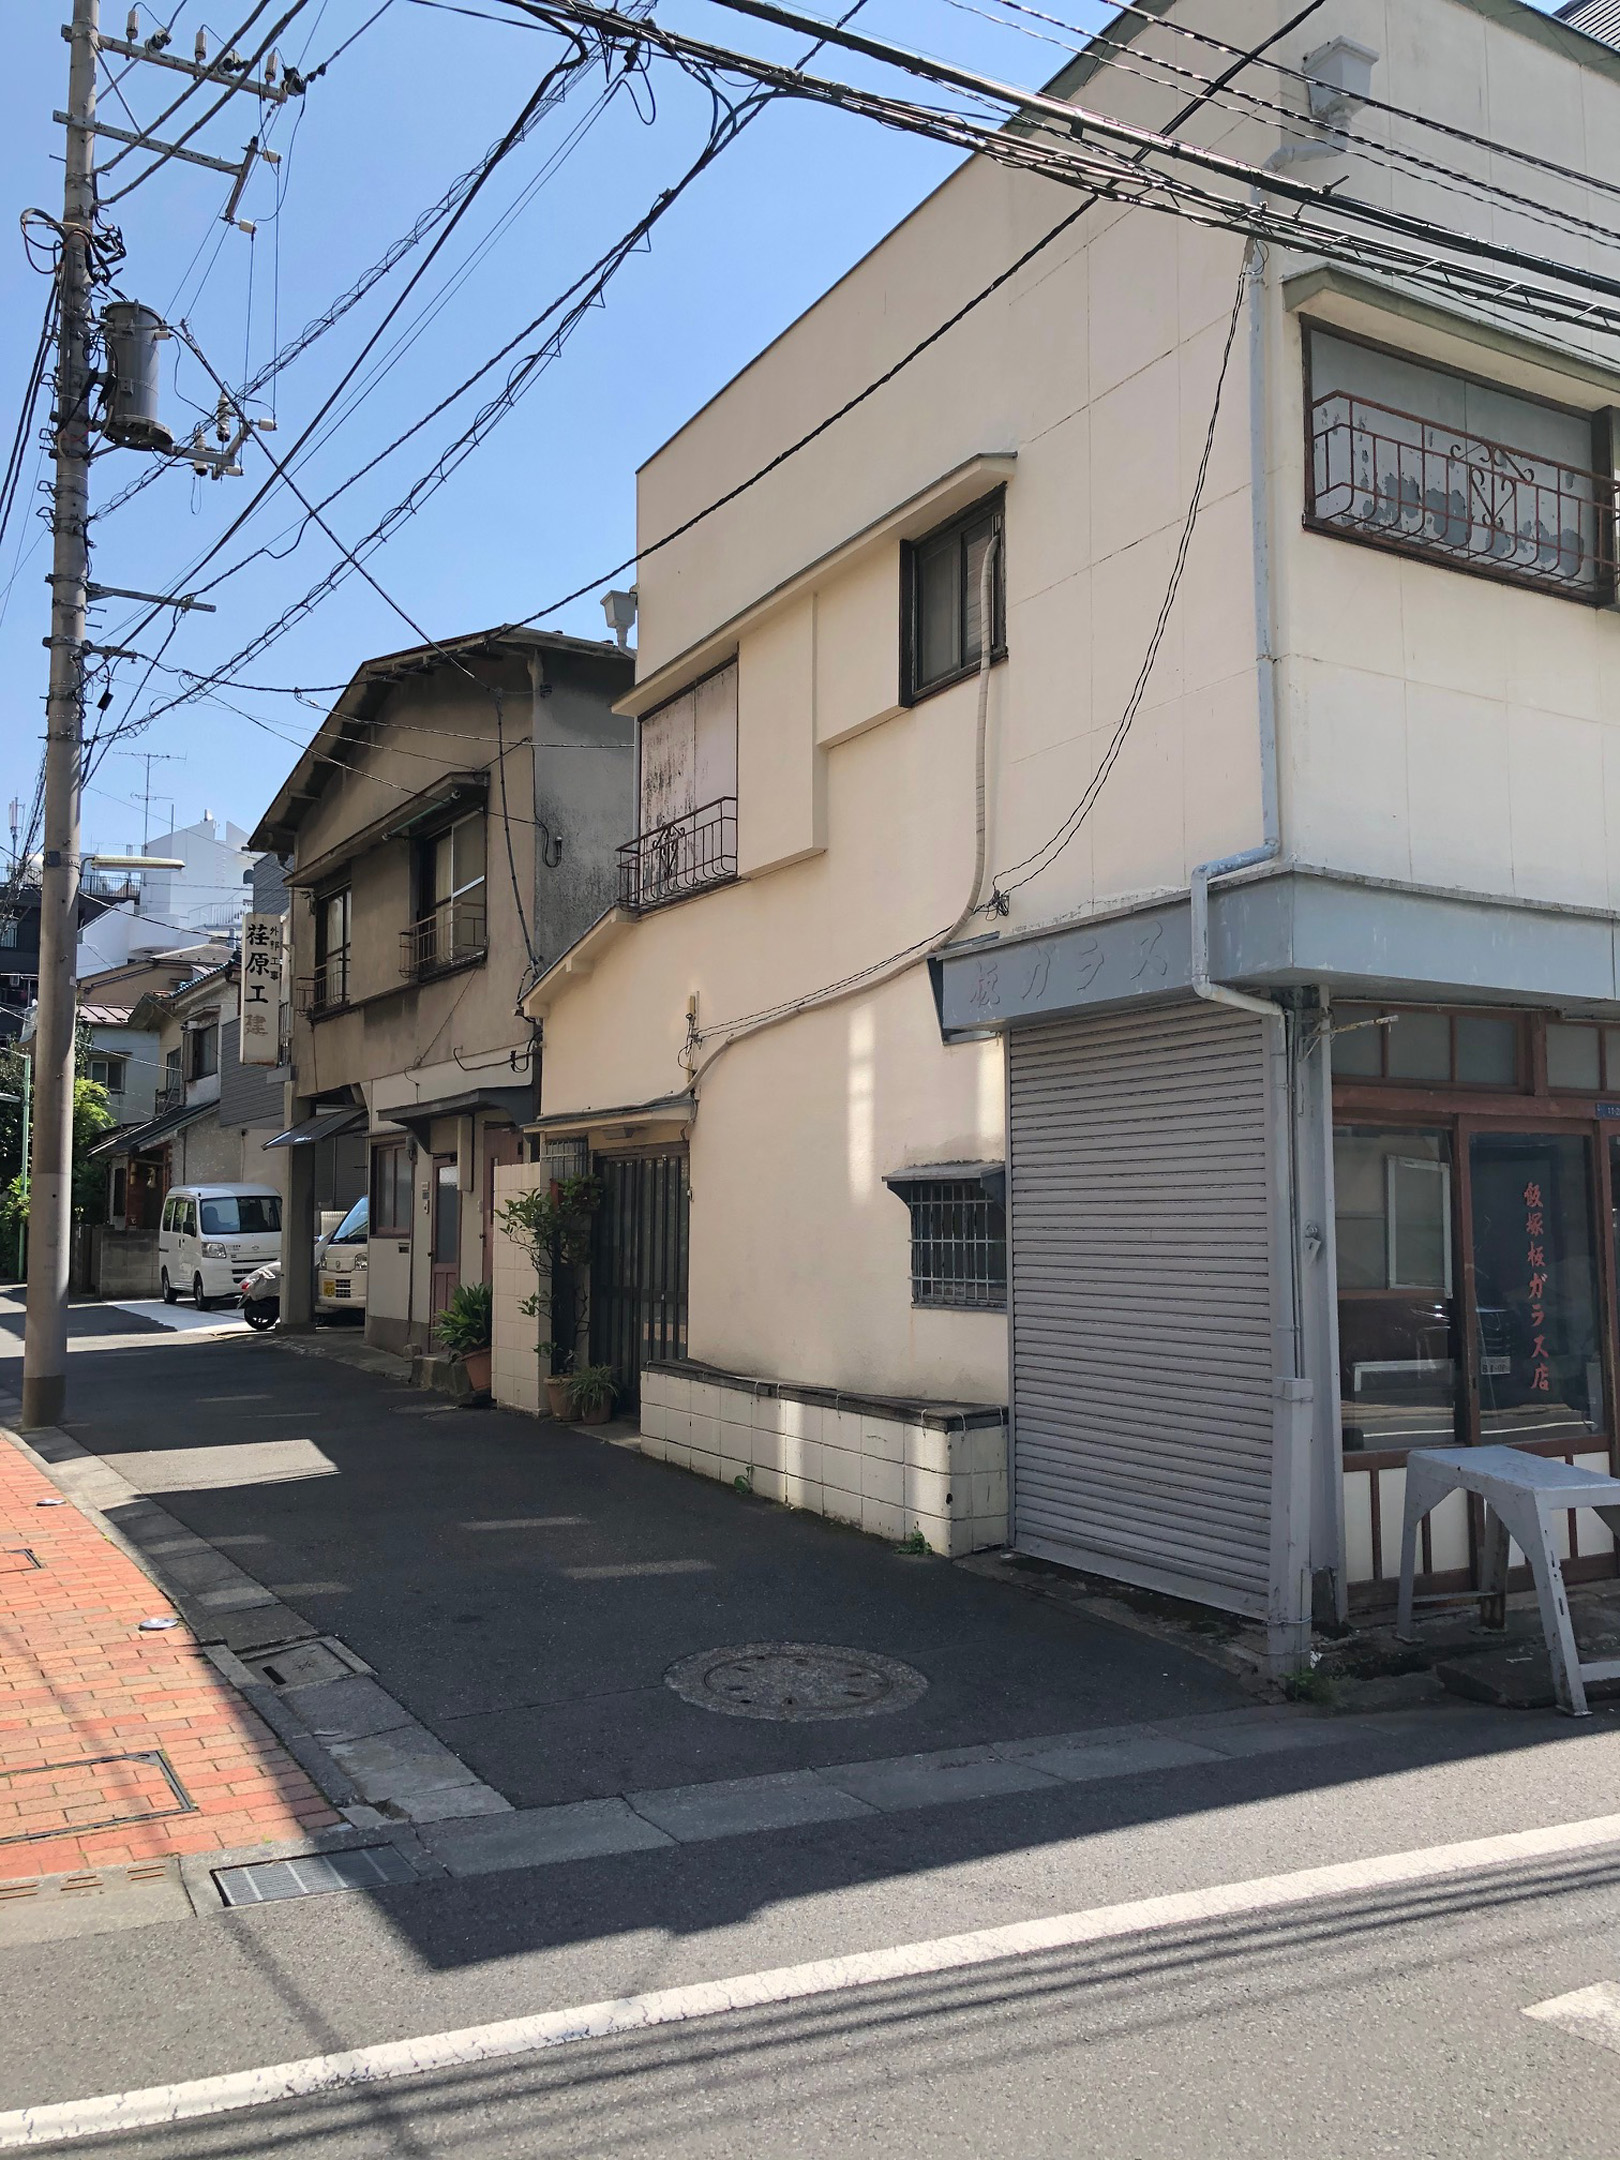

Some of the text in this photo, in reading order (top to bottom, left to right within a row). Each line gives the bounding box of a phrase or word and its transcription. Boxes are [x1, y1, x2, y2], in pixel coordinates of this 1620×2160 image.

[1523, 1181, 1550, 1392] 飯塚板ガラス店
